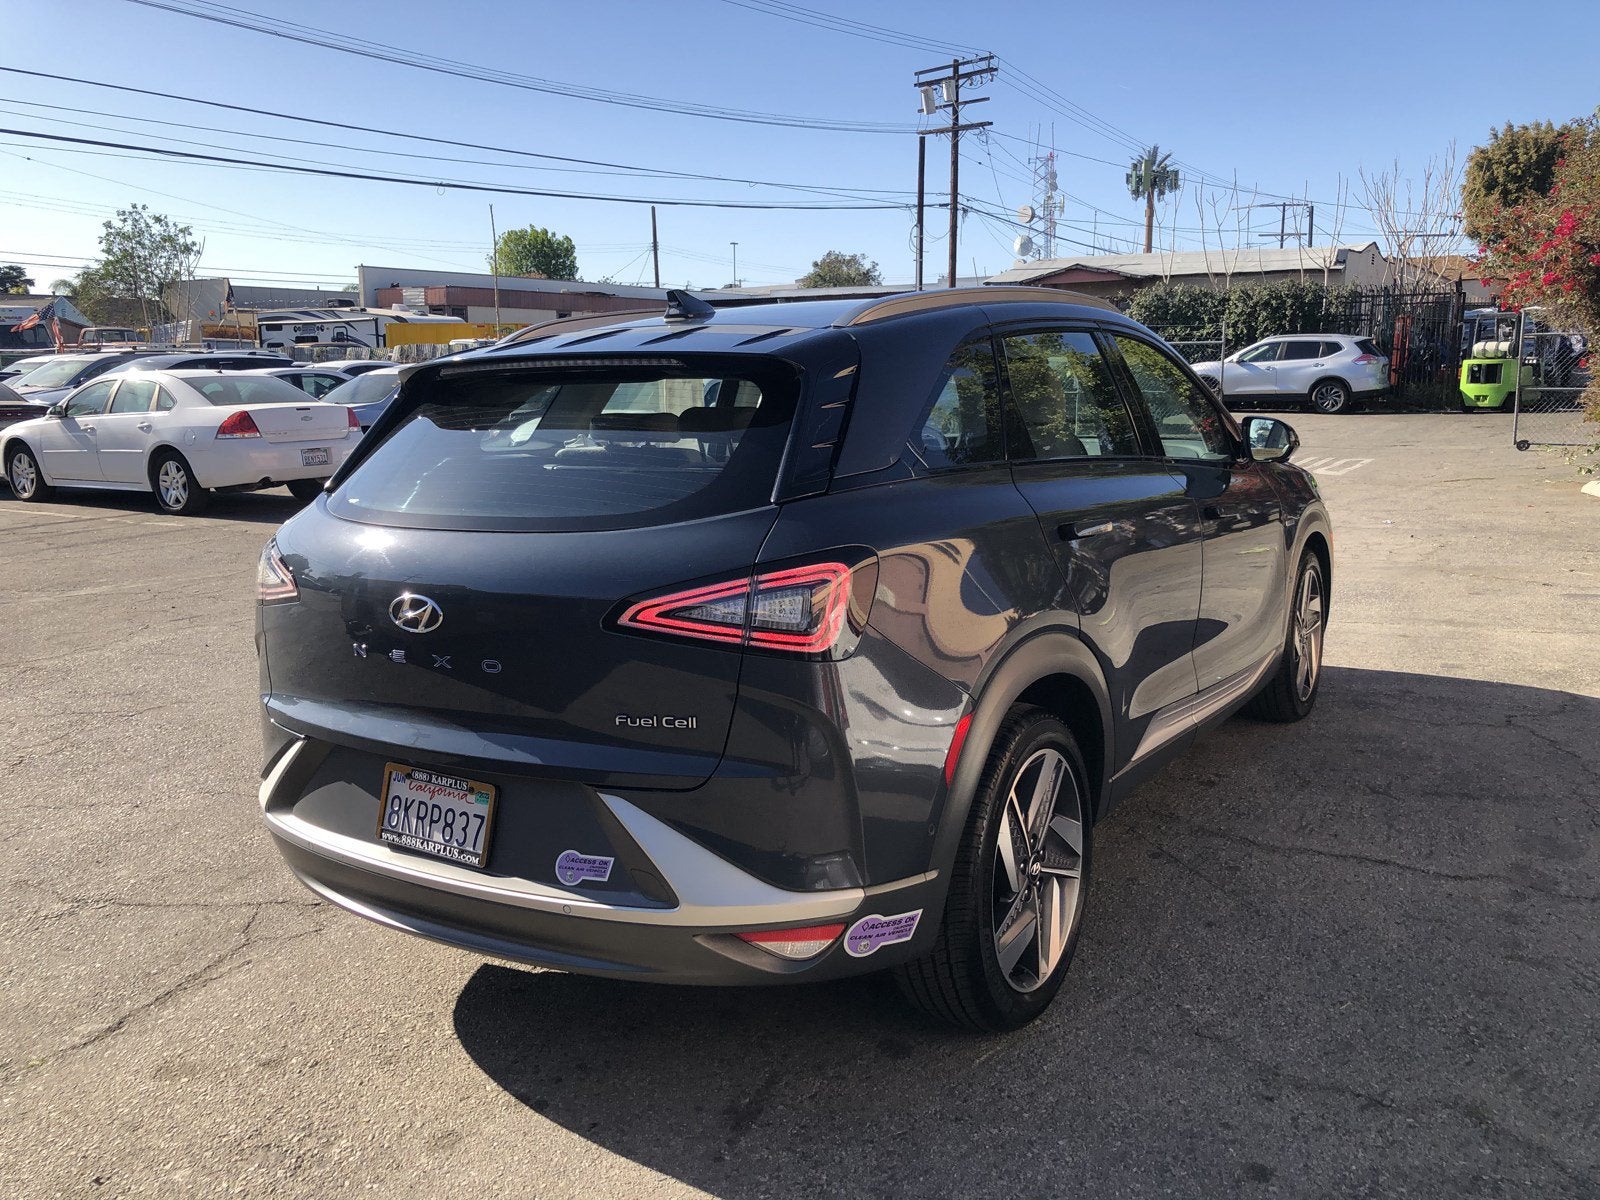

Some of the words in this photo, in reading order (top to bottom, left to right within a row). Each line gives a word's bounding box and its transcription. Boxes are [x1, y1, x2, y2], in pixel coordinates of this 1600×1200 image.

[352, 642, 502, 674] NEXO
[615, 715, 657, 727] Fuel
[662, 716, 697, 729] Cell
[411, 771, 429, 781] (888)
[431, 775, 468, 791] KARPLUS
[388, 795, 485, 850] 8KRP837
[570, 857, 596, 865] ACCESS
[868, 918, 903, 930] ACCESS
[904, 915, 917, 924] OK
[888, 927, 912, 936] VEHICLE
